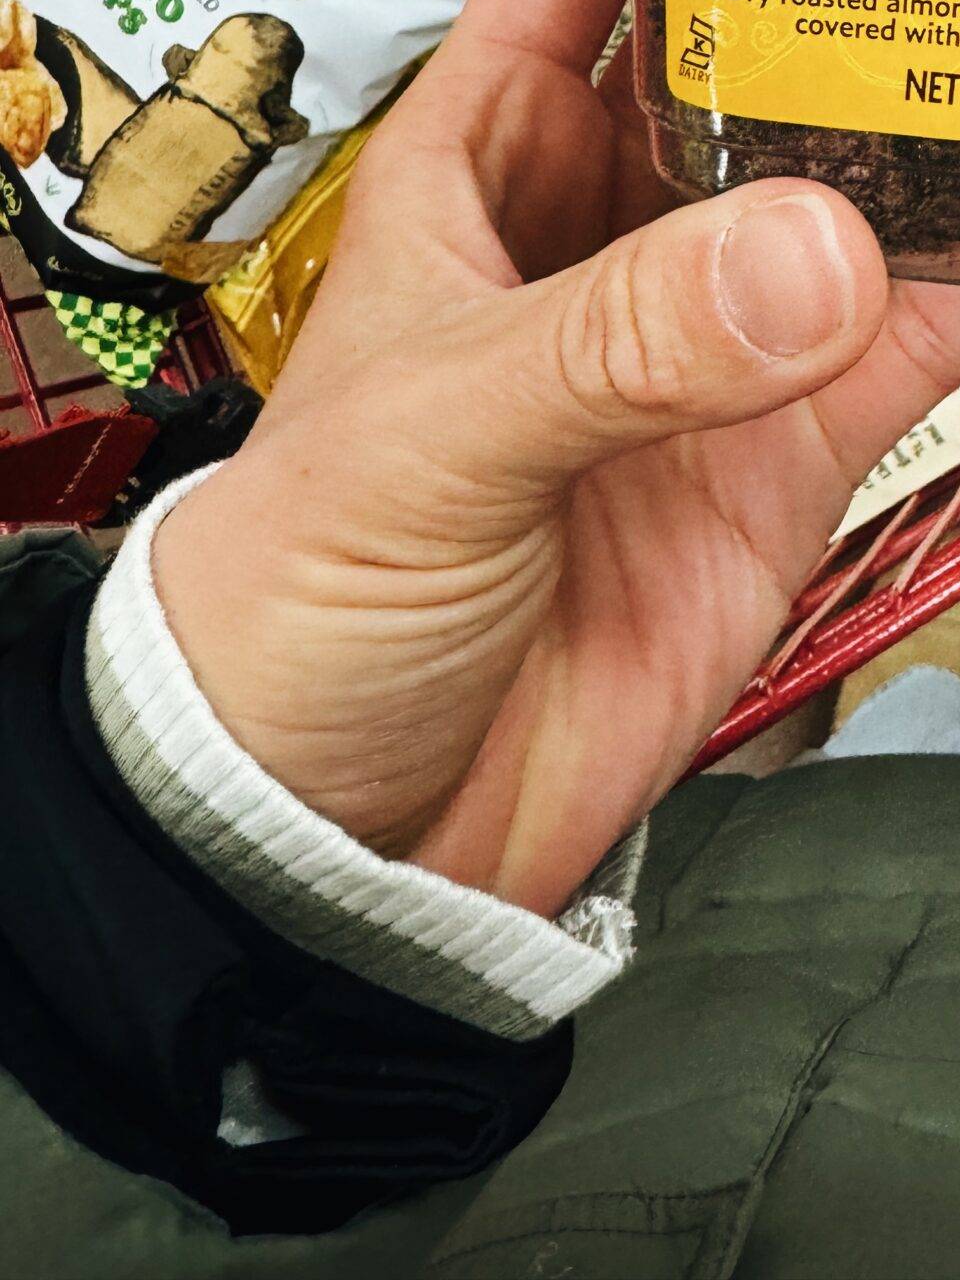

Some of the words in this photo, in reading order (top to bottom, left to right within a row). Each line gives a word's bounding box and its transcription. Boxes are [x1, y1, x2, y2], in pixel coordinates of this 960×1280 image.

[795, 17, 896, 41] covered
[904, 21, 960, 47] with
[678, 63, 712, 85] DAIRY
